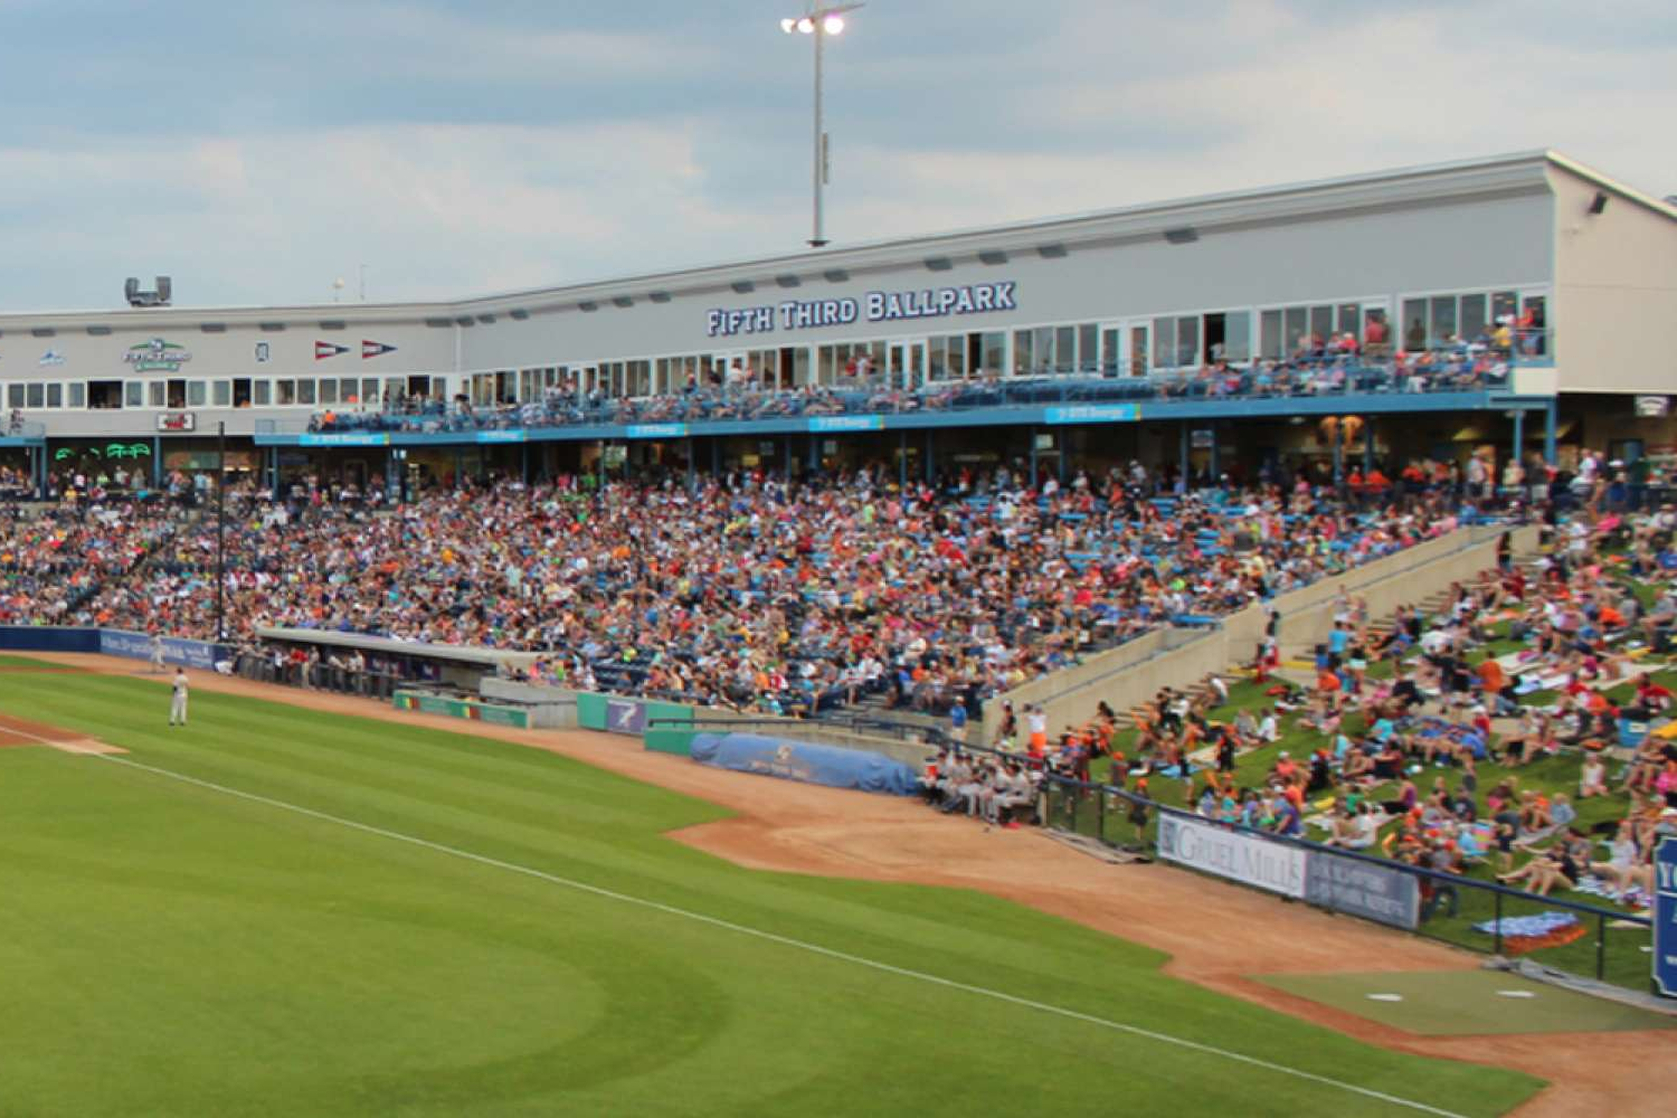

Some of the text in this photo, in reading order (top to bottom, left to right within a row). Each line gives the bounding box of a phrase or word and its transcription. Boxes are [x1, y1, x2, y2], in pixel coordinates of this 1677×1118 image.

[706, 281, 1016, 337] FIFTH THIRD BALLPARK
